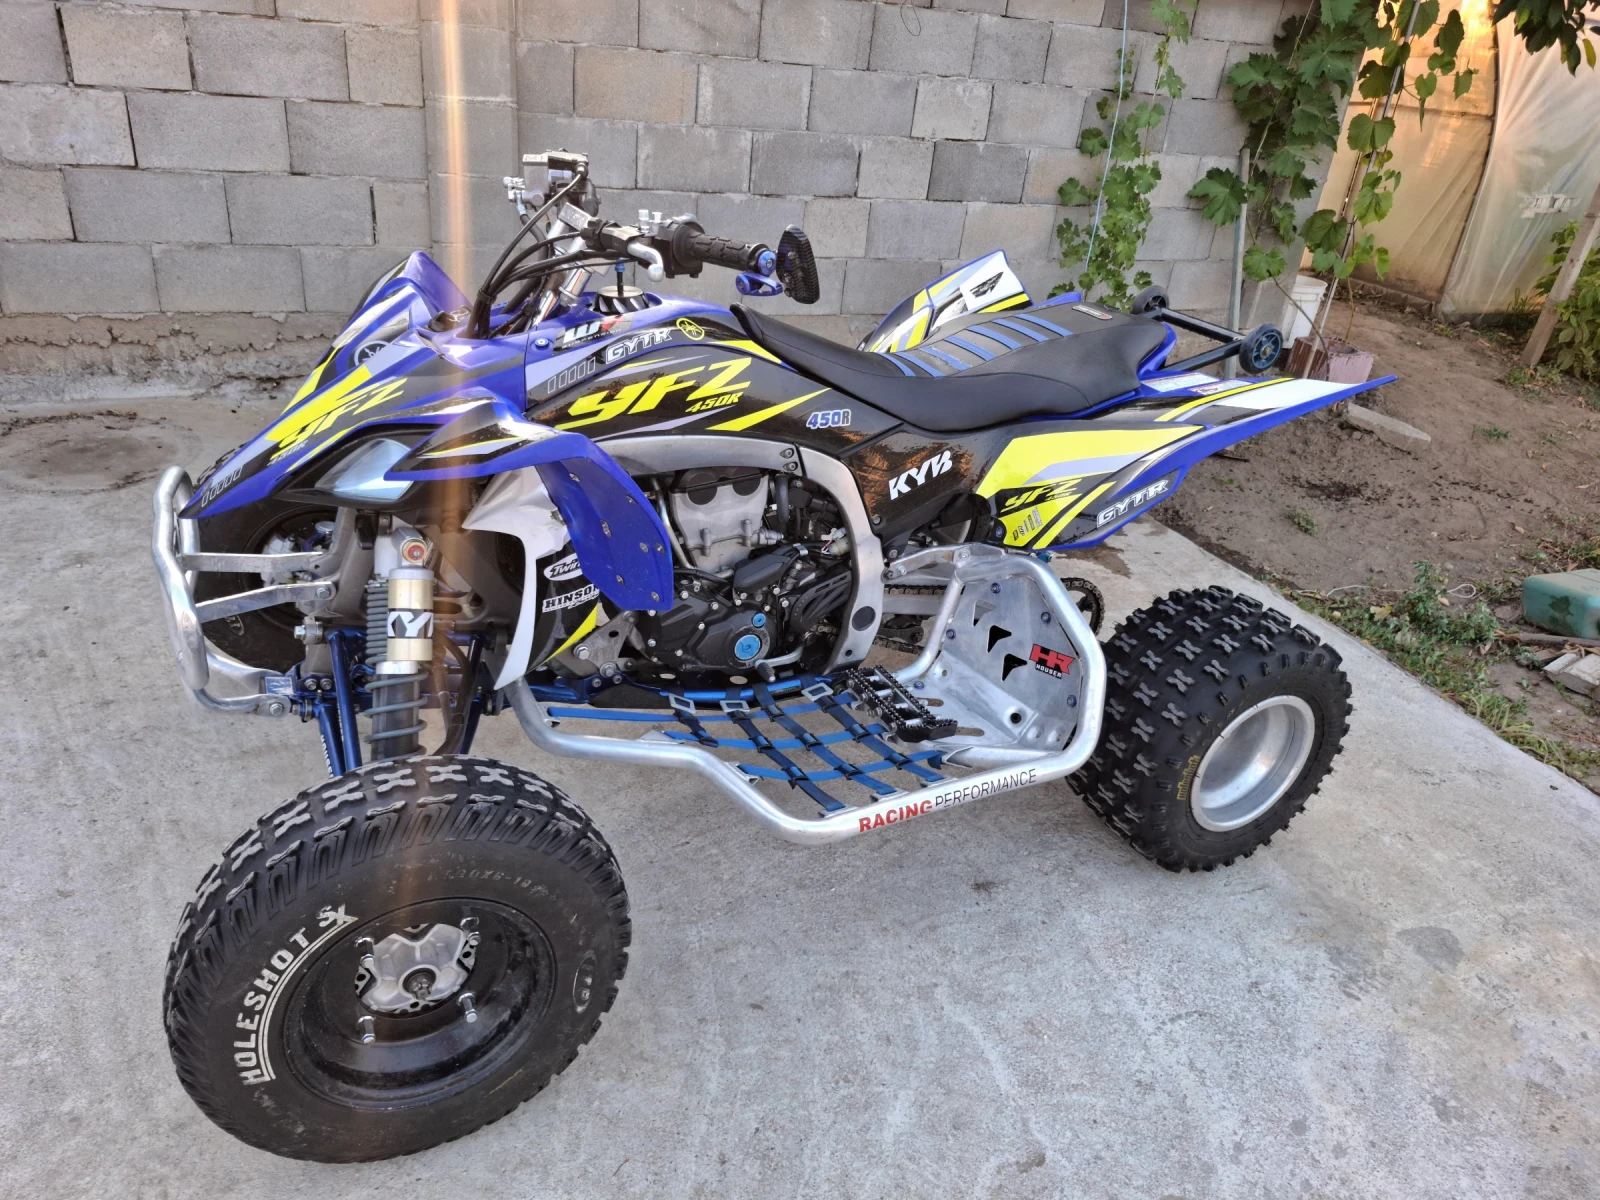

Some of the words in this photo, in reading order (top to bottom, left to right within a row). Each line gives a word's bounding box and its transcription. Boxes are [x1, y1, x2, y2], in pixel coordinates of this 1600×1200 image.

[606, 328, 672, 365] GYTR
[685, 392, 744, 413] 450R
[806, 409, 851, 428] 450R
[888, 450, 953, 501] KYB
[1096, 479, 1169, 528] GYTR
[387, 611, 434, 638] KY
[1035, 663, 1063, 678] HOUSER
[858, 799, 933, 833] RACING
[935, 768, 1037, 807] PERFORMANCE
[234, 927, 310, 1086] HOLESHOT
